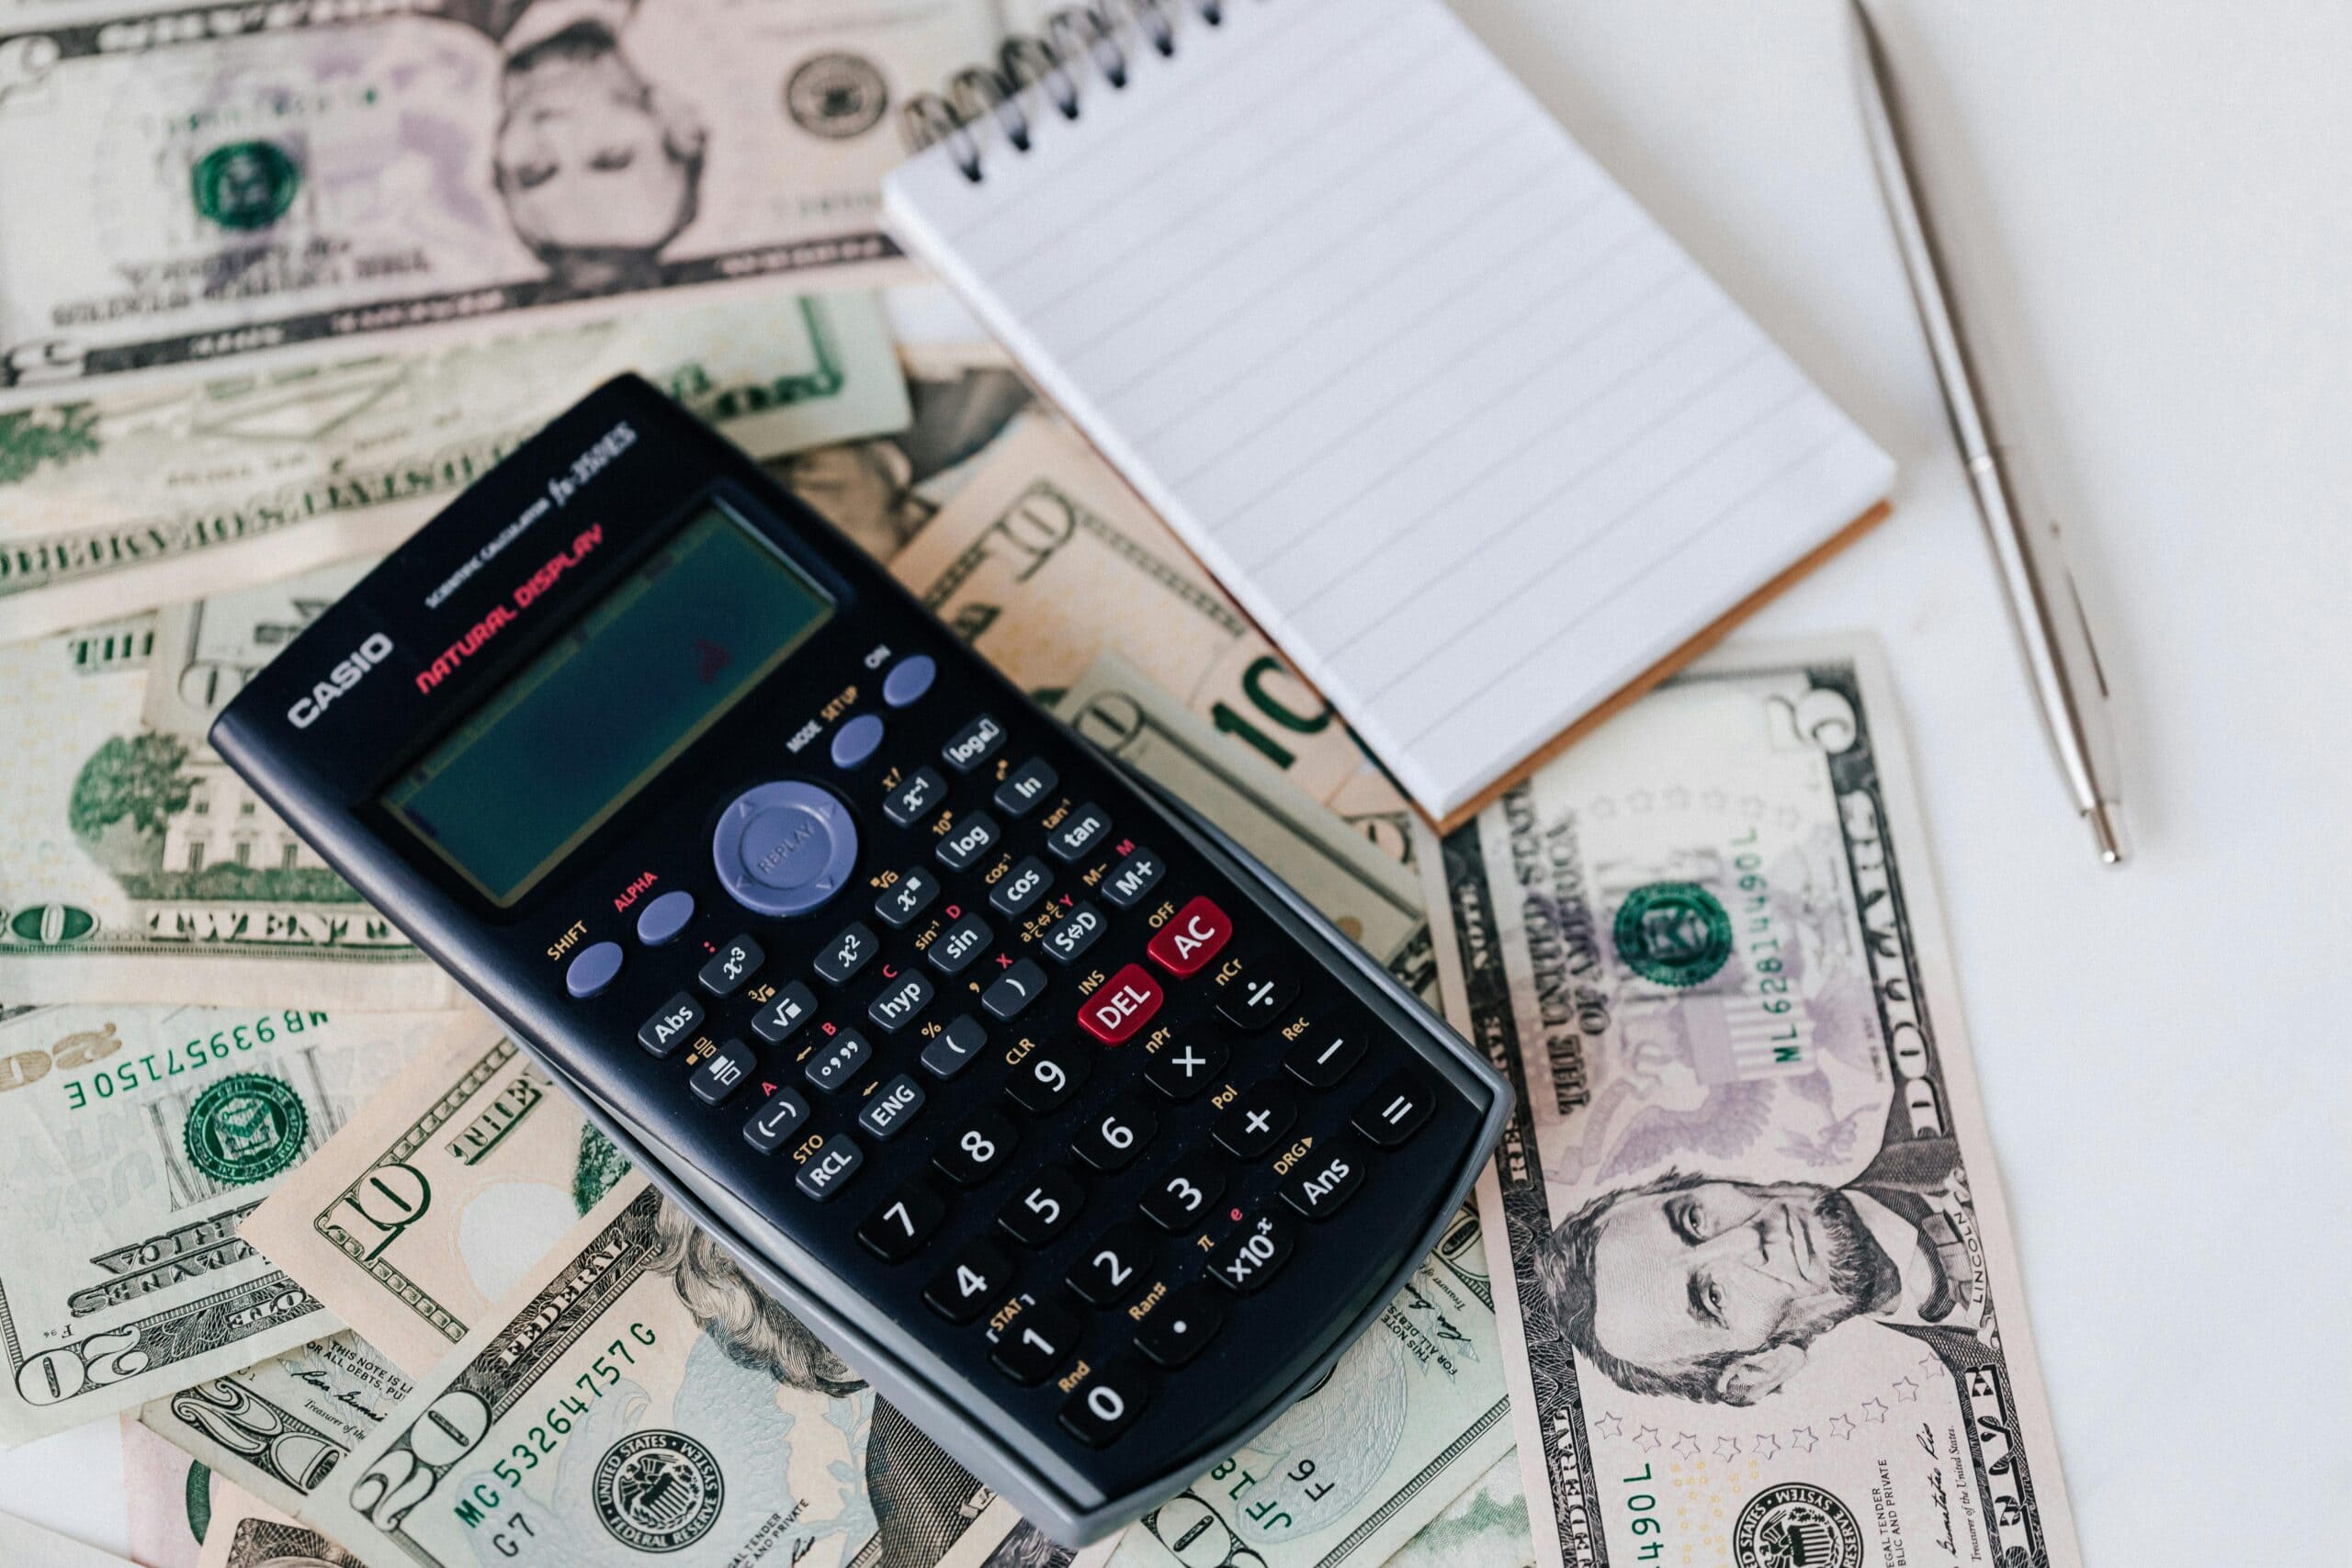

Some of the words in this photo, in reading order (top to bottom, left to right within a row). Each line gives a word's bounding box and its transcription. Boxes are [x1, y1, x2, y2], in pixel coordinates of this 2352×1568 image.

[416, 604, 517, 694] NATURAL
[513, 524, 604, 609] DISPLAY
[288, 632, 394, 729] CASIO
[1765, 688, 1857, 755] 5
[758, 820, 816, 874] REPLAY
[950, 825, 989, 857] log
[1064, 815, 1101, 848] tan
[1115, 838, 1136, 857] M
[613, 871, 659, 913] ALPHA
[1007, 869, 1040, 902] cos
[1115, 860, 1153, 897] M+
[945, 905, 961, 919] D
[1059, 893, 1073, 908] Y
[1148, 901, 1176, 929] OFF
[145, 908, 418, 948] TWENT
[547, 919, 589, 961] SHIFT
[946, 929, 978, 959] sin
[1173, 915, 1216, 960] AC
[882, 964, 897, 978] C
[996, 953, 1012, 969] X
[1215, 958, 1242, 987] nCr
[1840, 788, 1946, 1139] DOLLARS
[879, 983, 922, 1019] hyp
[1078, 970, 1105, 996] INS
[654, 1006, 694, 1043] Abs
[1095, 985, 1151, 1030] DEL
[821, 1021, 837, 1036] B
[1145, 1026, 1171, 1054] nPr
[1282, 1016, 1310, 1041] Rec
[1770, 1021, 1802, 1064] ML
[1005, 1038, 1035, 1065] CLR
[761, 1081, 777, 1097] A
[1034, 1060, 1066, 1092] 9
[1545, 1032, 1591, 1116] THE
[63, 1079, 87, 1111] E
[871, 1084, 916, 1127] ENG
[1211, 1084, 1238, 1110] Pol
[445, 1077, 544, 1166] THE
[1102, 1116, 1134, 1148] 6
[793, 1134, 823, 1164] STO
[960, 1131, 995, 1163] 8
[809, 1151, 853, 1187] RCL
[1303, 1157, 1351, 1205] Ans
[324, 1162, 432, 1263] 10
[1023, 1187, 1060, 1224] 5
[1167, 1177, 1203, 1212] 3
[882, 1201, 915, 1236] 7
[1092, 1249, 1133, 1286] 2
[1954, 1212, 1984, 1303] LINCOLN
[956, 1264, 988, 1297] 4
[1433, 1276, 1465, 1312] Treasurer
[223, 1286, 309, 1330] OTE
[498, 1236, 633, 1365] FEDERAL
[989, 1297, 1022, 1332] STAT
[1128, 1281, 1168, 1321] Ran#
[1023, 1327, 1055, 1355] 1
[1381, 1314, 1408, 1340] NOTE
[323, 1350, 344, 1368] ALL
[331, 1340, 356, 1361] THIS
[356, 1358, 389, 1380] NOTE
[387, 1374, 401, 1387] IS
[1407, 1339, 1430, 1364] THIS
[1419, 1337, 1439, 1355] ALL
[15, 1323, 150, 1406] 20
[1058, 1359, 1091, 1393] Rnd
[1436, 1356, 1458, 1376] FOR
[304, 1398, 345, 1427] Treasurer
[343, 1422, 356, 1434] of
[1087, 1385, 1125, 1421] 0
[172, 1378, 342, 1492] 20
[453, 1484, 501, 1529] MG
[492, 1339, 636, 1488] 53264757
[629, 1323, 656, 1346] G
[349, 1389, 492, 1532] 20
[599, 1457, 622, 1506] UNITED
[622, 1435, 667, 1458] STATES
[680, 1441, 718, 1492] SYSTEM
[1953, 1457, 1968, 1488] United
[1964, 1363, 2038, 1559] FIVE
[1878, 1459, 1896, 1507] PRIVATE
[673, 1495, 718, 1545] RESERVE
[754, 1538, 775, 1561] AND
[774, 1498, 810, 1540] PRIVATE
[1245, 1501, 1293, 1531] JF
[1740, 1503, 1767, 1547] STATES
[1775, 1489, 1833, 1511] SYSTEM
[1871, 1487, 1887, 1536] TENDER
[1891, 1509, 1904, 1535] AND
[609, 1516, 669, 1548] FEDERAL
[744, 1512, 782, 1553] TENDER
